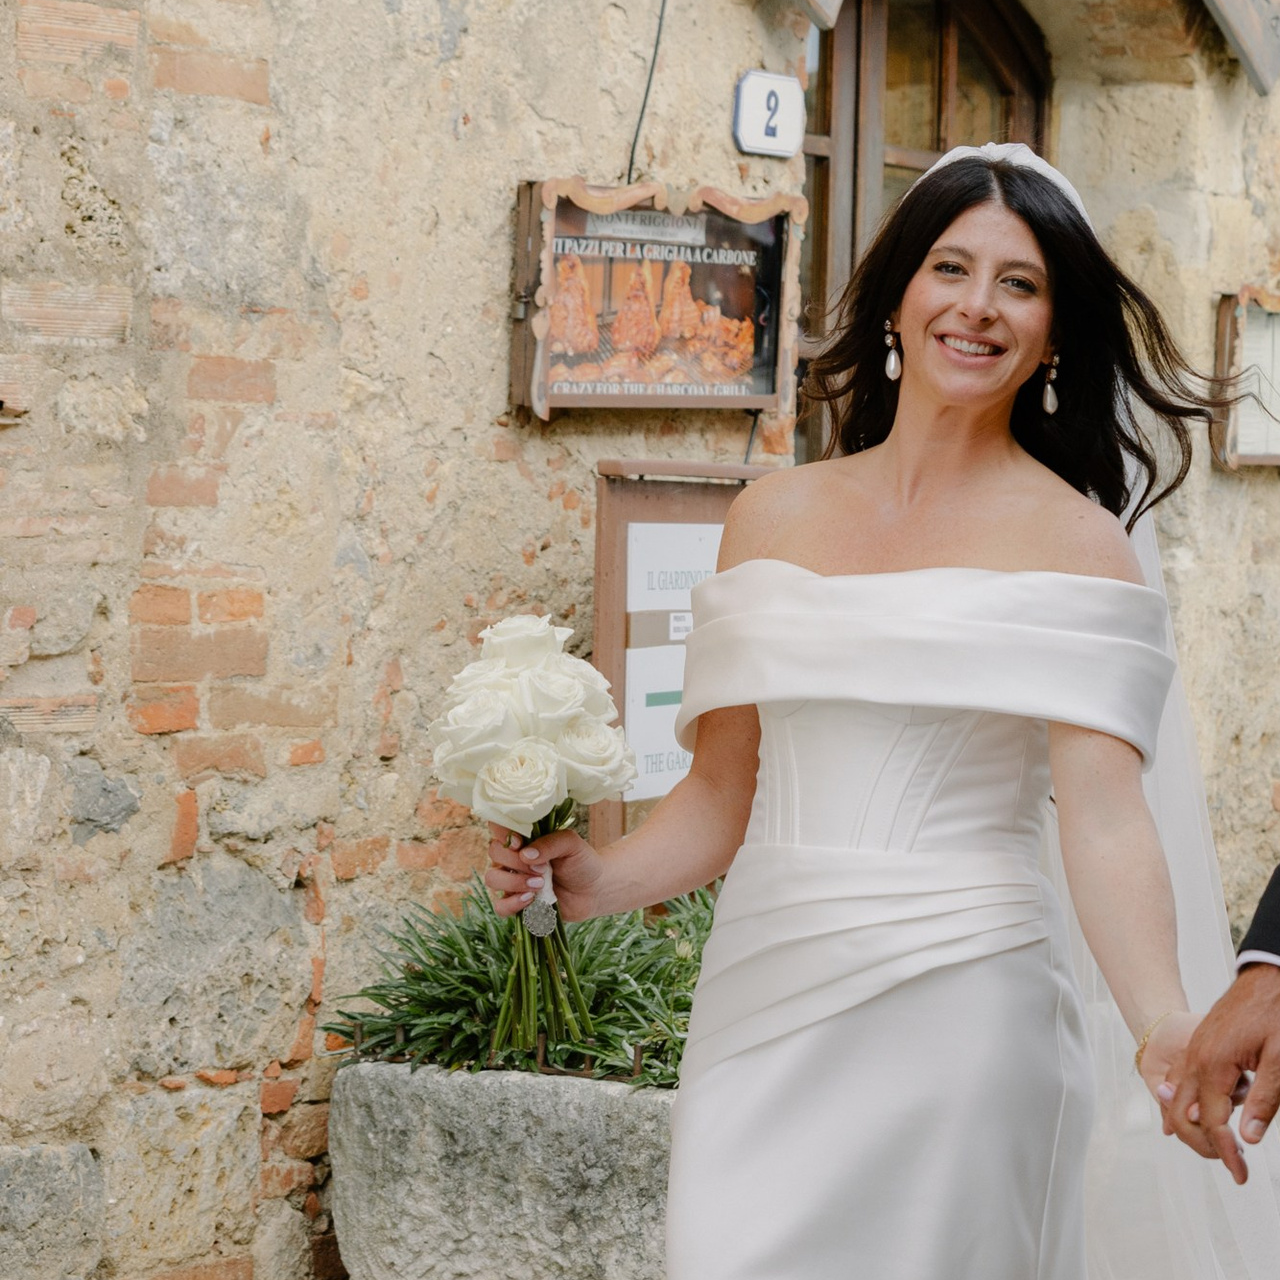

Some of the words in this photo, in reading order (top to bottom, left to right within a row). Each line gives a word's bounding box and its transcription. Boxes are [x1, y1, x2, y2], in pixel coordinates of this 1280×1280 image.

[765, 89, 780, 138] 2
[564, 238, 599, 256] PAZZI
[601, 240, 625, 258] PER
[626, 242, 642, 259] LA
[642, 243, 693, 263] GRIGLIA
[693, 247, 702, 263] A
[702, 247, 758, 266] CARBONE
[553, 382, 595, 395] CRAZY
[596, 382, 620, 395] FOR
[623, 383, 645, 395] THE
[647, 571, 657, 591] IL
[644, 753, 665, 774] THE
